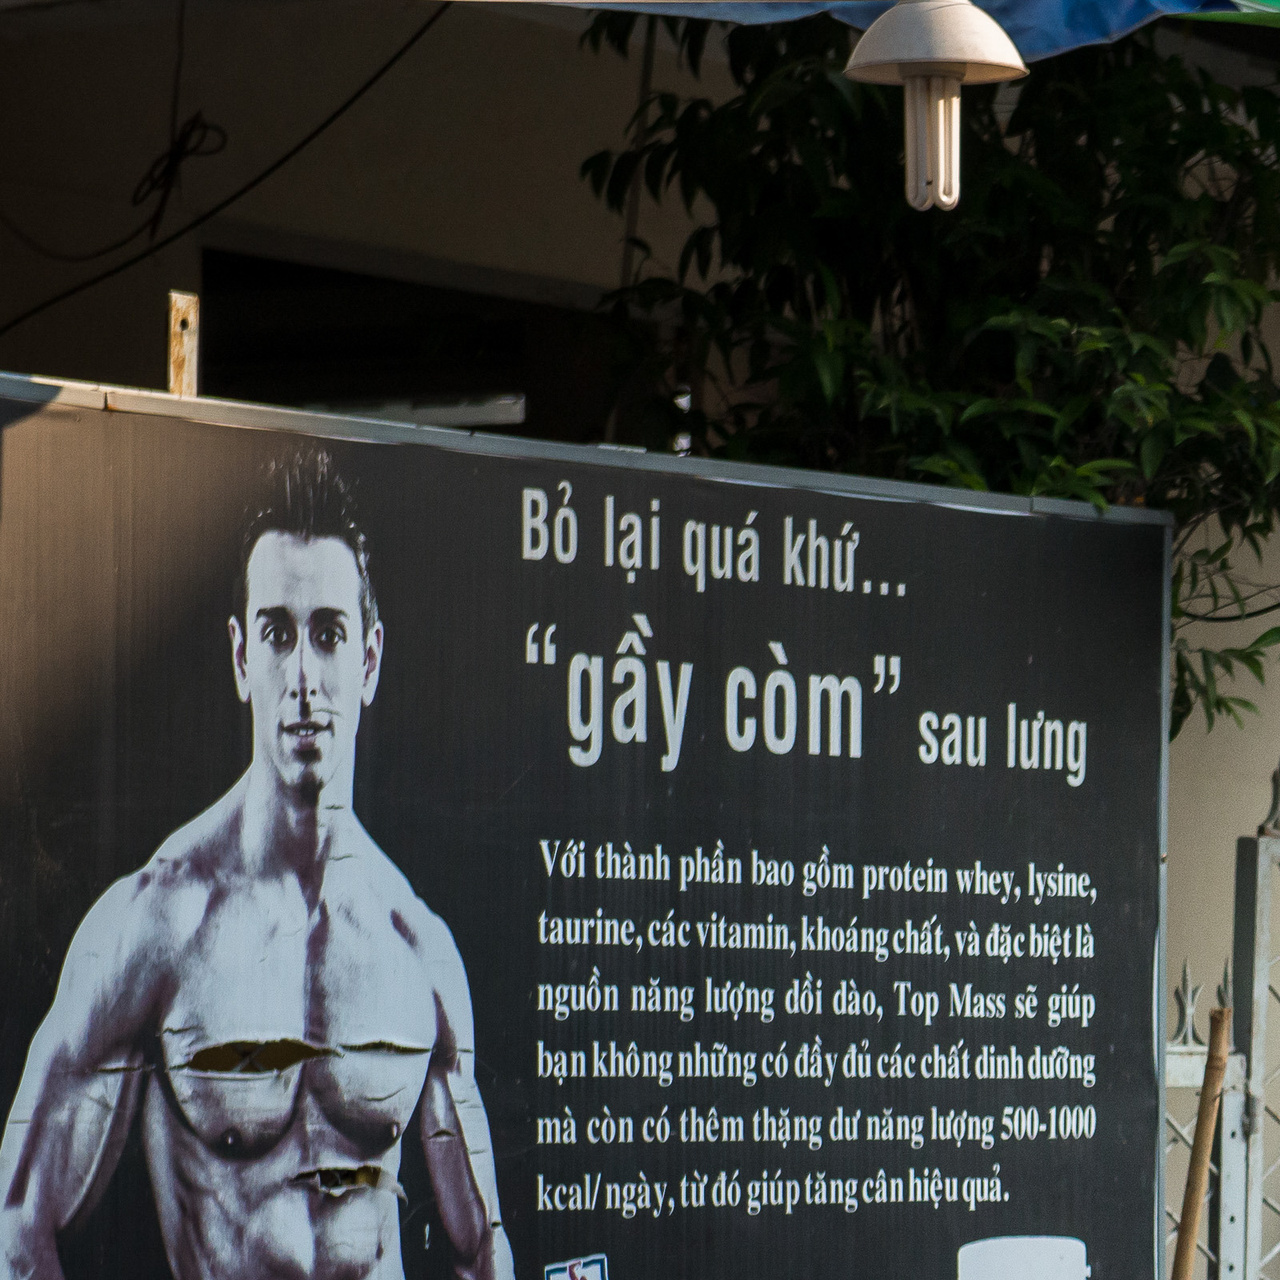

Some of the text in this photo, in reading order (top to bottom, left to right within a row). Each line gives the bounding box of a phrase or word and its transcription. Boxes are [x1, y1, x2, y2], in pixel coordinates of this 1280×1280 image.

[522, 480, 906, 597] Bỏ lại quá khứ...
[525, 613, 1087, 788] “gầy còm” sau lưng
[539, 838, 1098, 906] Với thành phần bao gồm protein whey, lysine,
[538, 907, 1095, 966] taurine, các vitamin, khoáng chất, và đặc biệt là
[537, 965, 1096, 1028] nguồn năng lượng dồi dào, Top Mass sẽ giúp
[537, 1034, 1097, 1089] bạn không những có đầy đủ các chất dinh dưỡng
[536, 1104, 1097, 1151] mà còn có thêm thặng dư năng lượng 500-1000
[537, 1162, 1010, 1219] kcal/ngày, từ đó giúp tăng cân hiệu quả.
